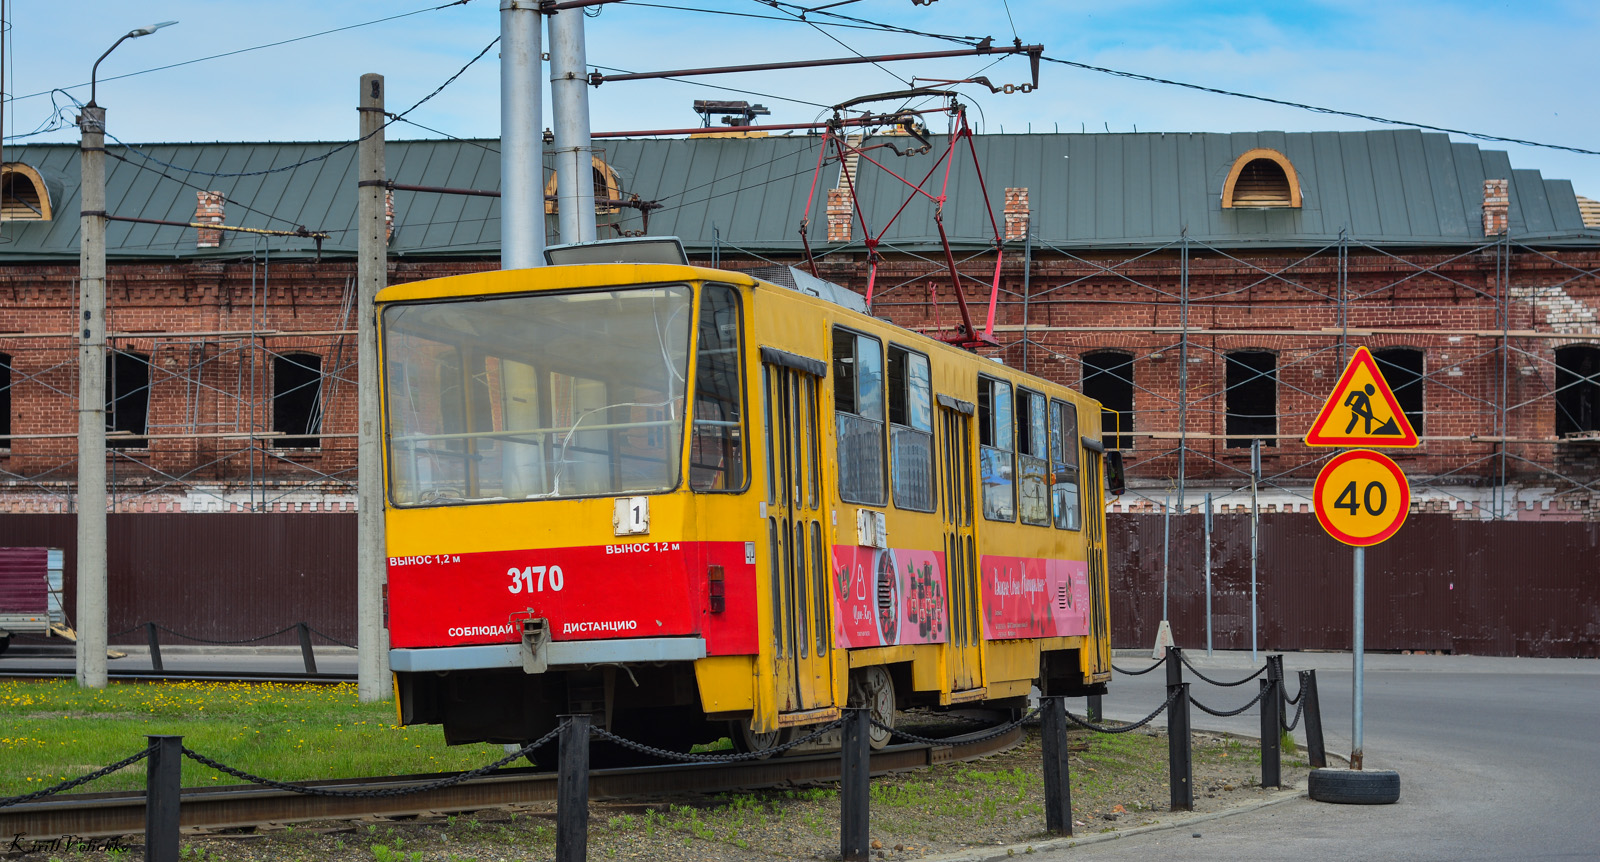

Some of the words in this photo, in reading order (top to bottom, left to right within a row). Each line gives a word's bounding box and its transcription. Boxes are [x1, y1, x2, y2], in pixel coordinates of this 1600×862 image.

[1333, 480, 1387, 516] 40
[632, 505, 640, 525] 1
[605, 543, 650, 555] ВЫНОС
[653, 542, 669, 552] 1,2
[389, 555, 432, 567] ВЫНОС
[435, 554, 450, 566] 1,2
[507, 565, 564, 594] 3170
[448, 624, 514, 637] СОБЛЮДАЙ
[563, 620, 637, 633] ДИСТАНЦИЮ
